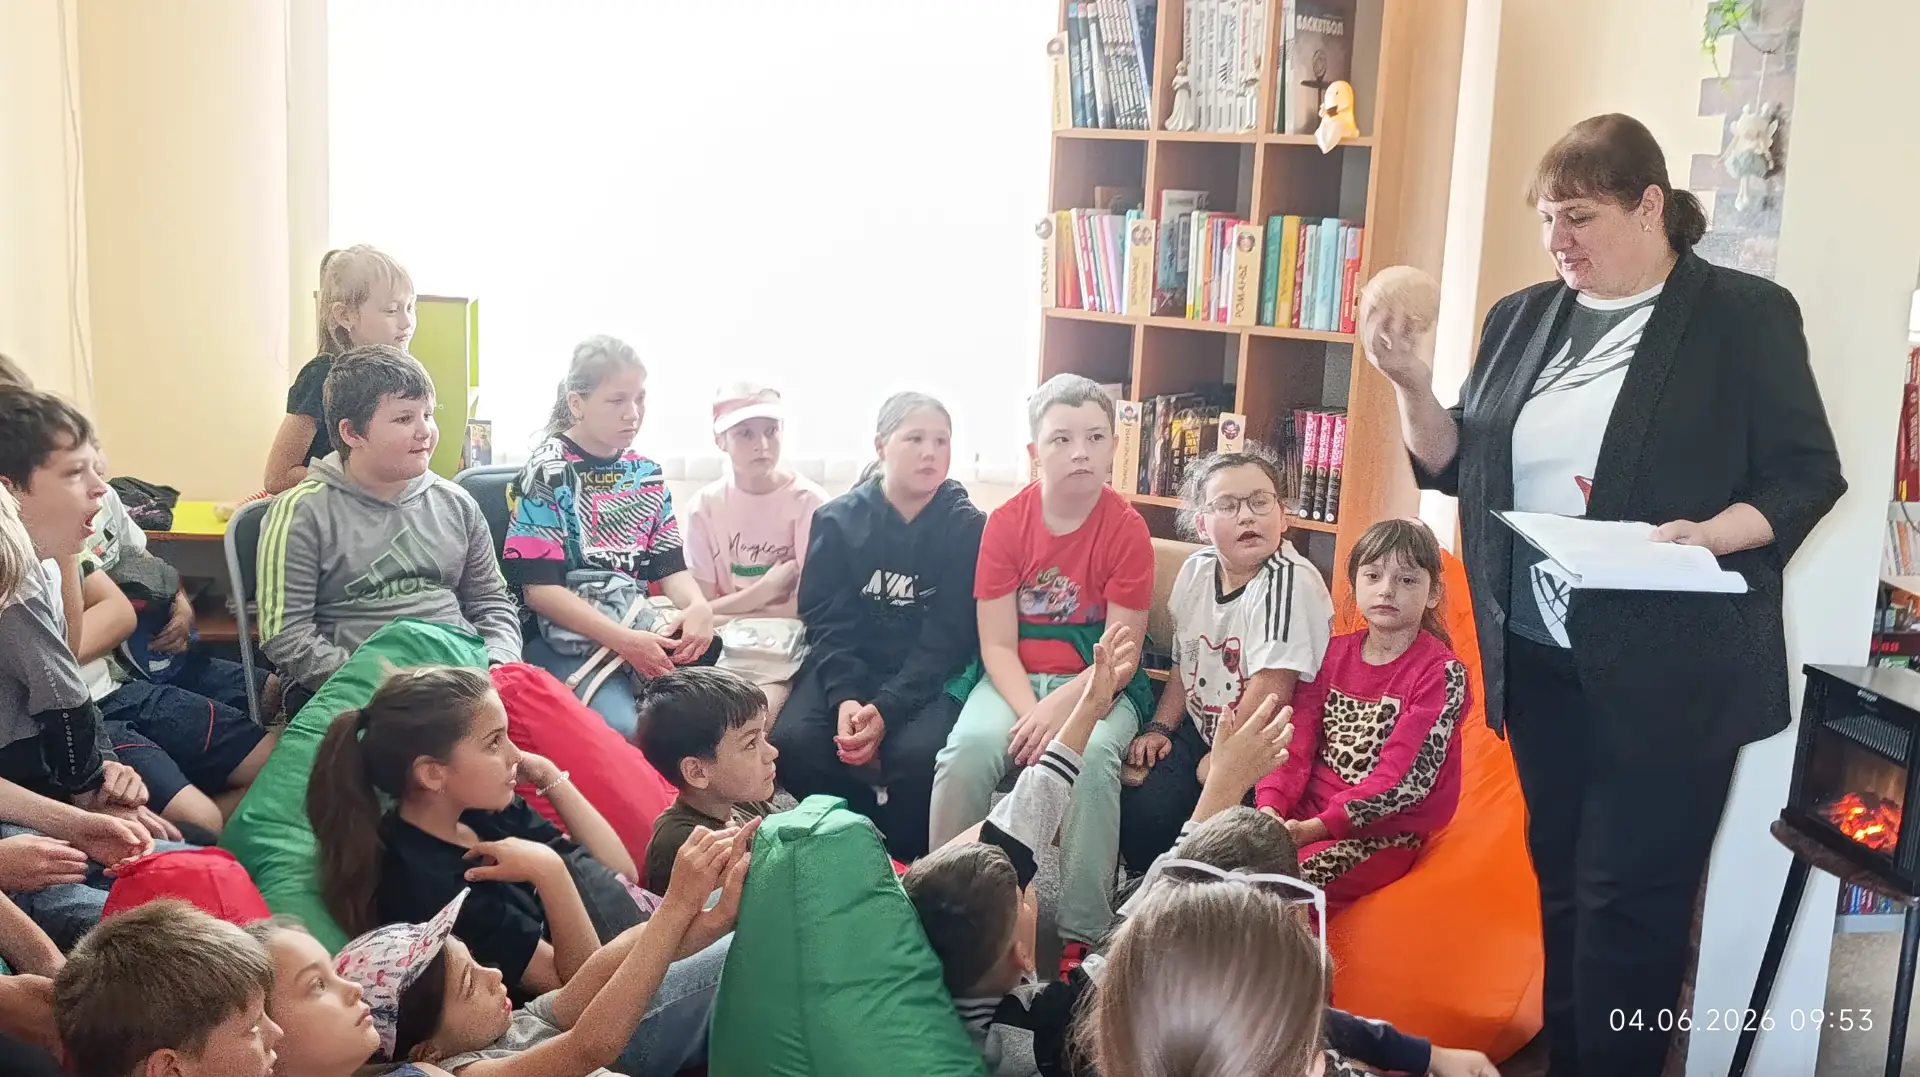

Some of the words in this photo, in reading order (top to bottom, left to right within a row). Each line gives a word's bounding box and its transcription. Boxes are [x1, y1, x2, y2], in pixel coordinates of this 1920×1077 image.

[1040, 246, 1049, 294] СКАЗКИ
[1234, 264, 1248, 318] РОМАНЫ
[1121, 428, 1132, 490] ПРИКЛЮЧЕНИЯ
